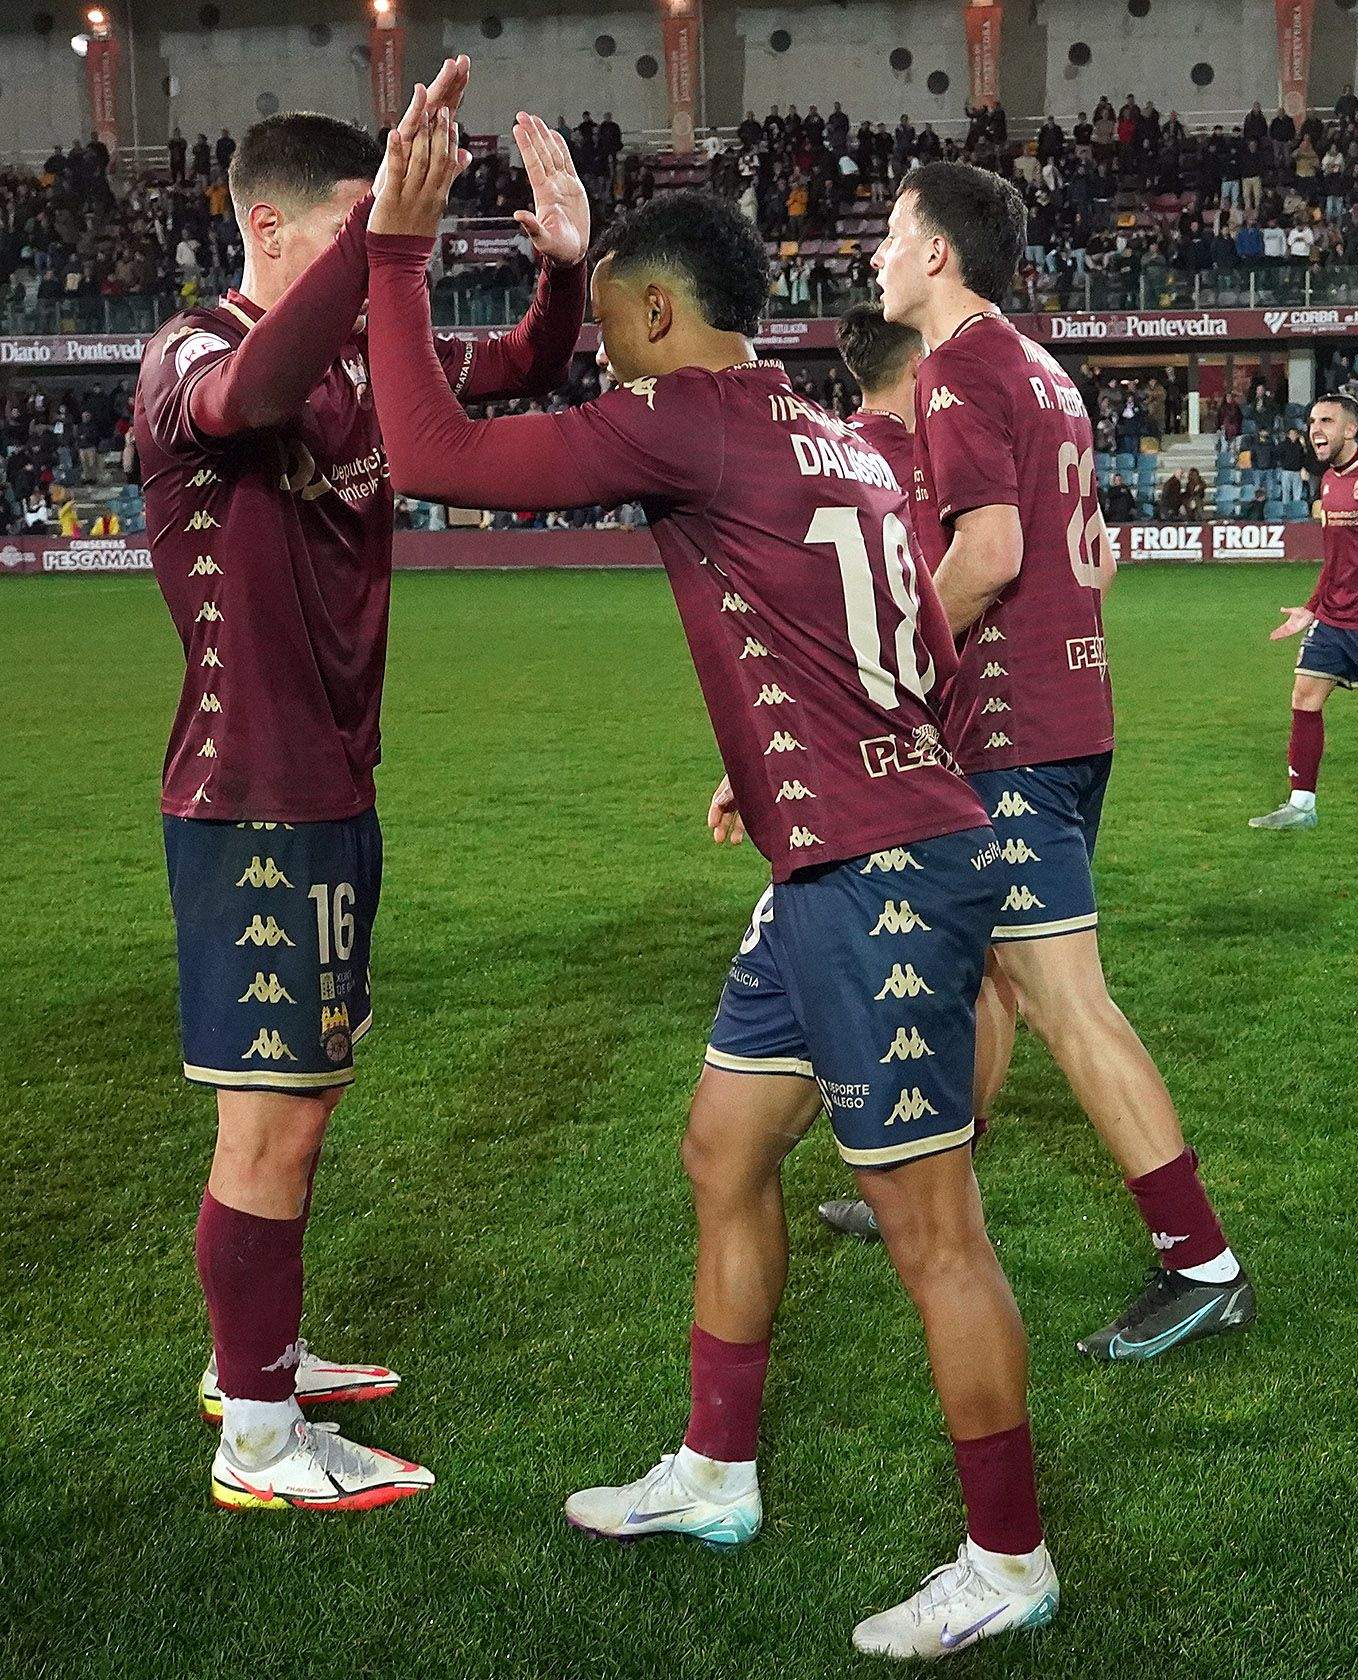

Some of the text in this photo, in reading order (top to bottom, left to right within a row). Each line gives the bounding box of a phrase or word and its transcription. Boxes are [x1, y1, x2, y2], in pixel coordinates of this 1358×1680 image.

[1050, 315, 1107, 338] Diario
[1126, 313, 1228, 337] Pontevedra
[0, 339, 145, 362] Diario Ponteved
[1130, 526, 1203, 550] FROIZ
[1212, 525, 1285, 549] FROIZ
[43, 549, 153, 571] PESCAMAR
[307, 882, 355, 964] 16
